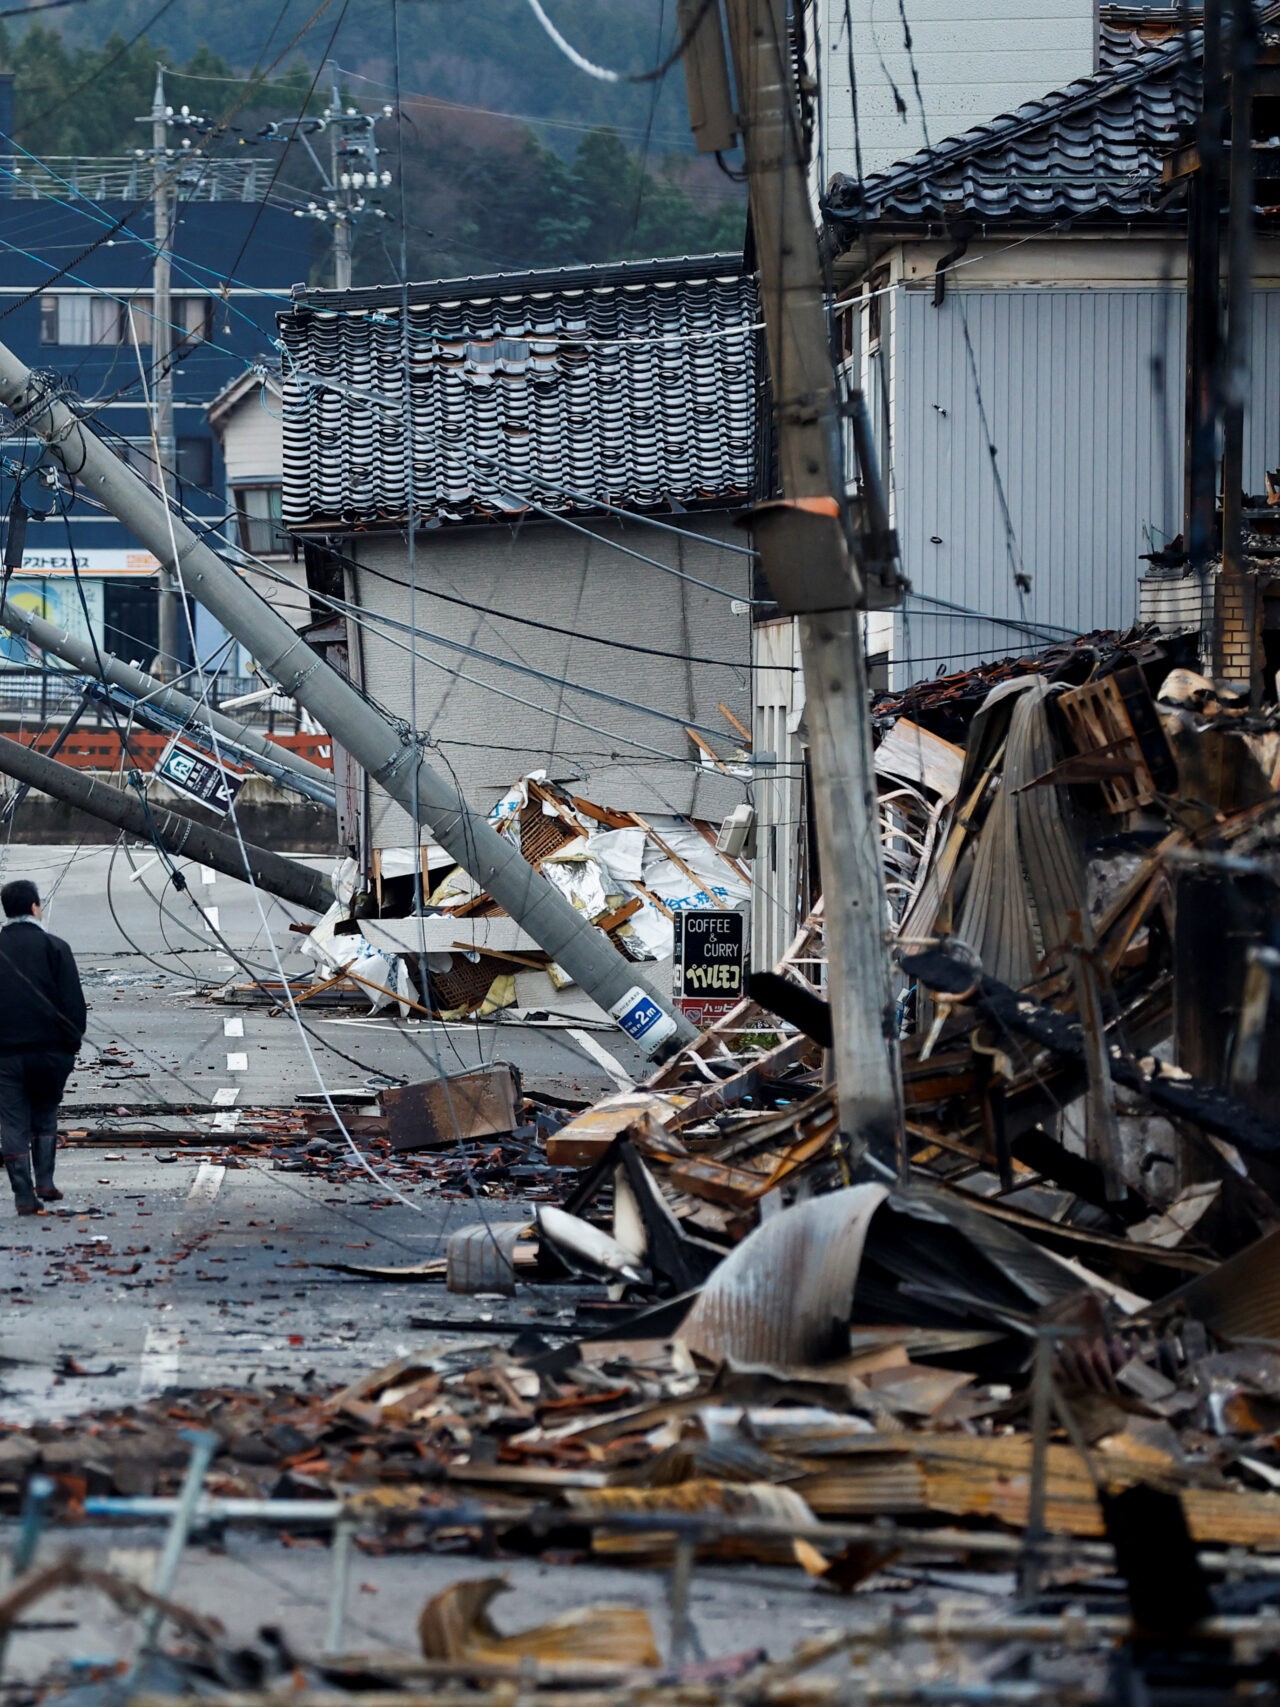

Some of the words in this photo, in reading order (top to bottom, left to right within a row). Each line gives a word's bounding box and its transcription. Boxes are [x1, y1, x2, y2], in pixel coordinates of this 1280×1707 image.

[687, 918, 731, 933] COFFEE
[709, 933, 717, 943] &
[704, 943, 739, 957] CURRY
